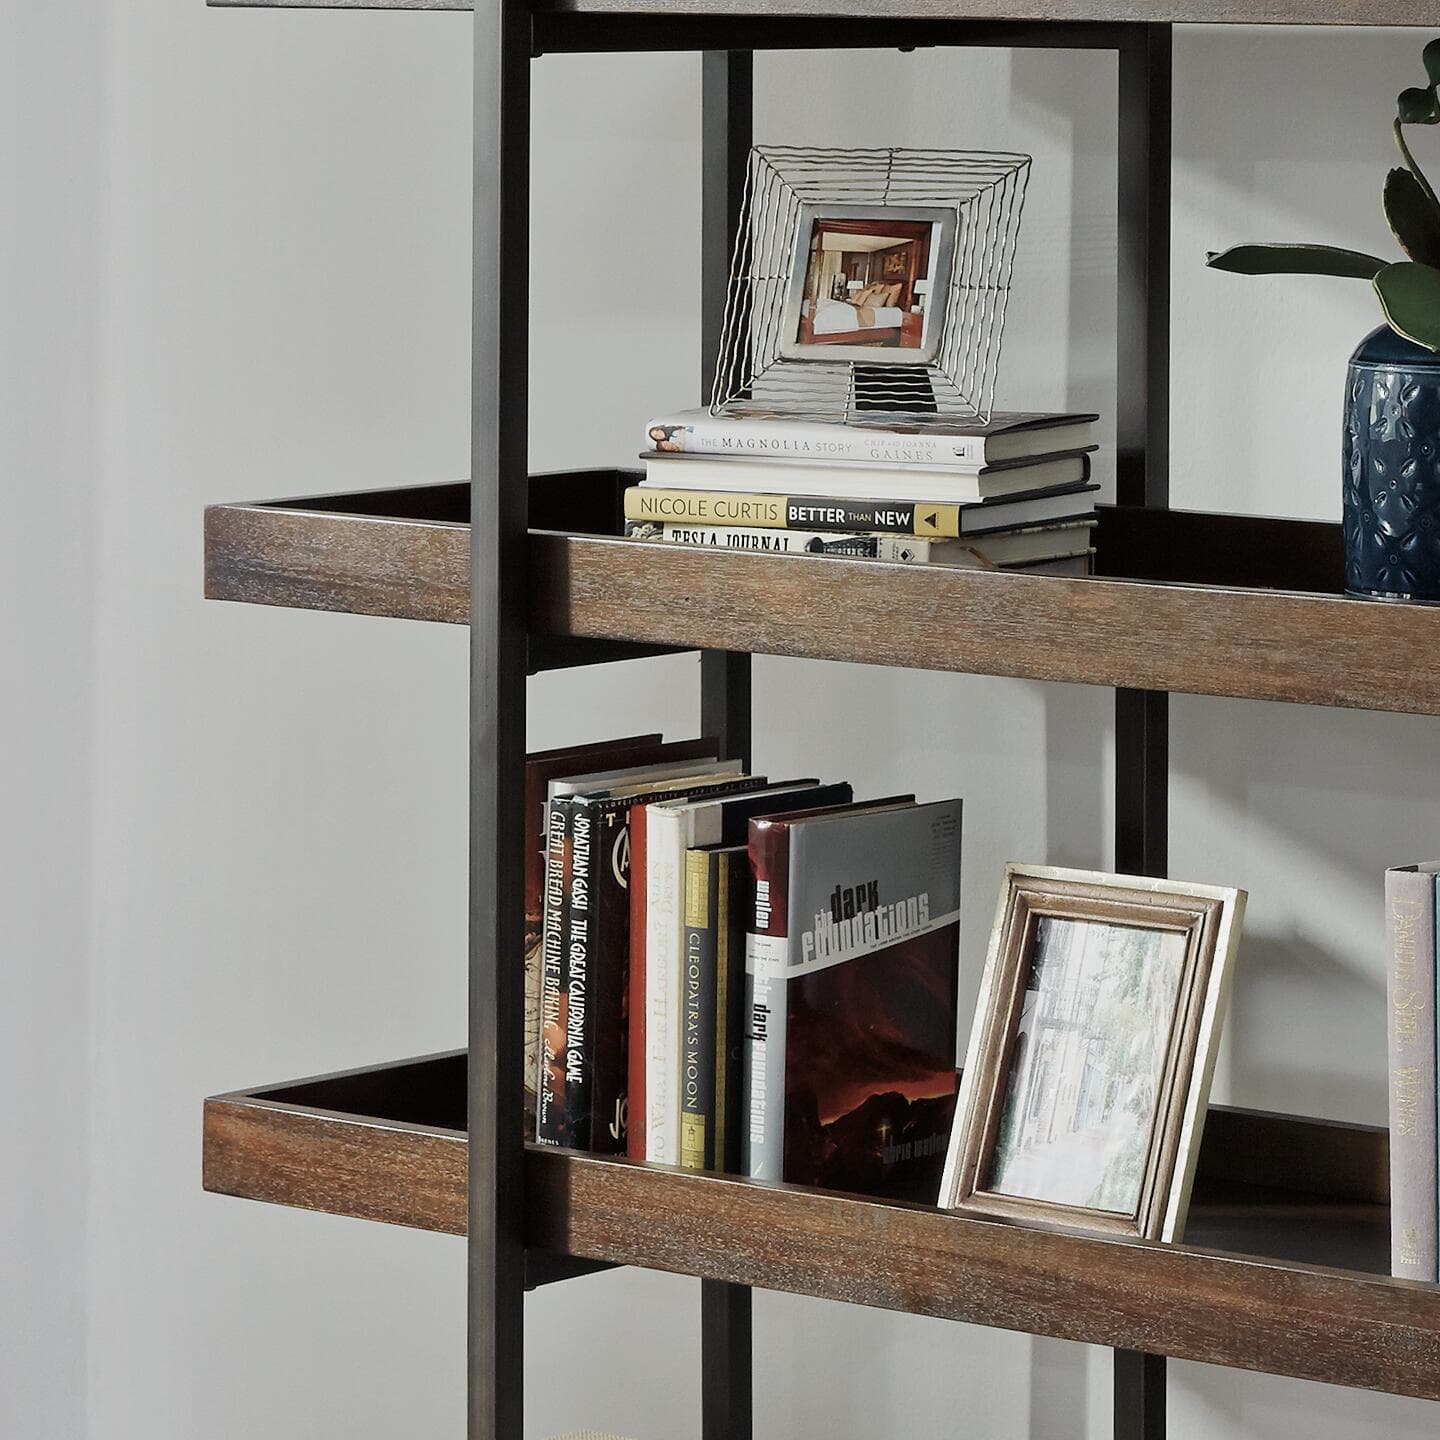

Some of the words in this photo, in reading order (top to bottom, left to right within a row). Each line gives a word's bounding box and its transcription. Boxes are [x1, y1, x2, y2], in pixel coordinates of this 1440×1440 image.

[701, 438, 719, 447] THE
[722, 437, 811, 451] MAGNOLIA
[816, 442, 852, 453] STORY
[870, 448, 934, 460] GAINES
[641, 497, 707, 517] NICOLE
[714, 501, 778, 521] CURTIS
[788, 505, 845, 523] BETTER
[848, 511, 872, 522] THAN
[874, 510, 911, 526] NEW
[672, 529, 717, 545] TESLA
[726, 534, 789, 552] JOURNAL
[550, 811, 566, 857] GREAT
[572, 813, 591, 877] JONATHAN
[548, 860, 564, 906] BREAD
[571, 878, 589, 910] GASH
[830, 879, 880, 924] dark
[546, 908, 563, 975] MACHINE
[570, 919, 588, 942] THE
[802, 892, 929, 964] foundations
[569, 943, 587, 982] GREAT
[543, 976, 561, 1031] BAKING
[686, 932, 700, 1045] CLEOPATRA'S
[567, 980, 586, 1048] CALIFORNIA
[746, 1003, 771, 1040] dark
[565, 1050, 584, 1084] GAME
[686, 1051, 699, 1108] MOON
[541, 1088, 554, 1124] Brown
